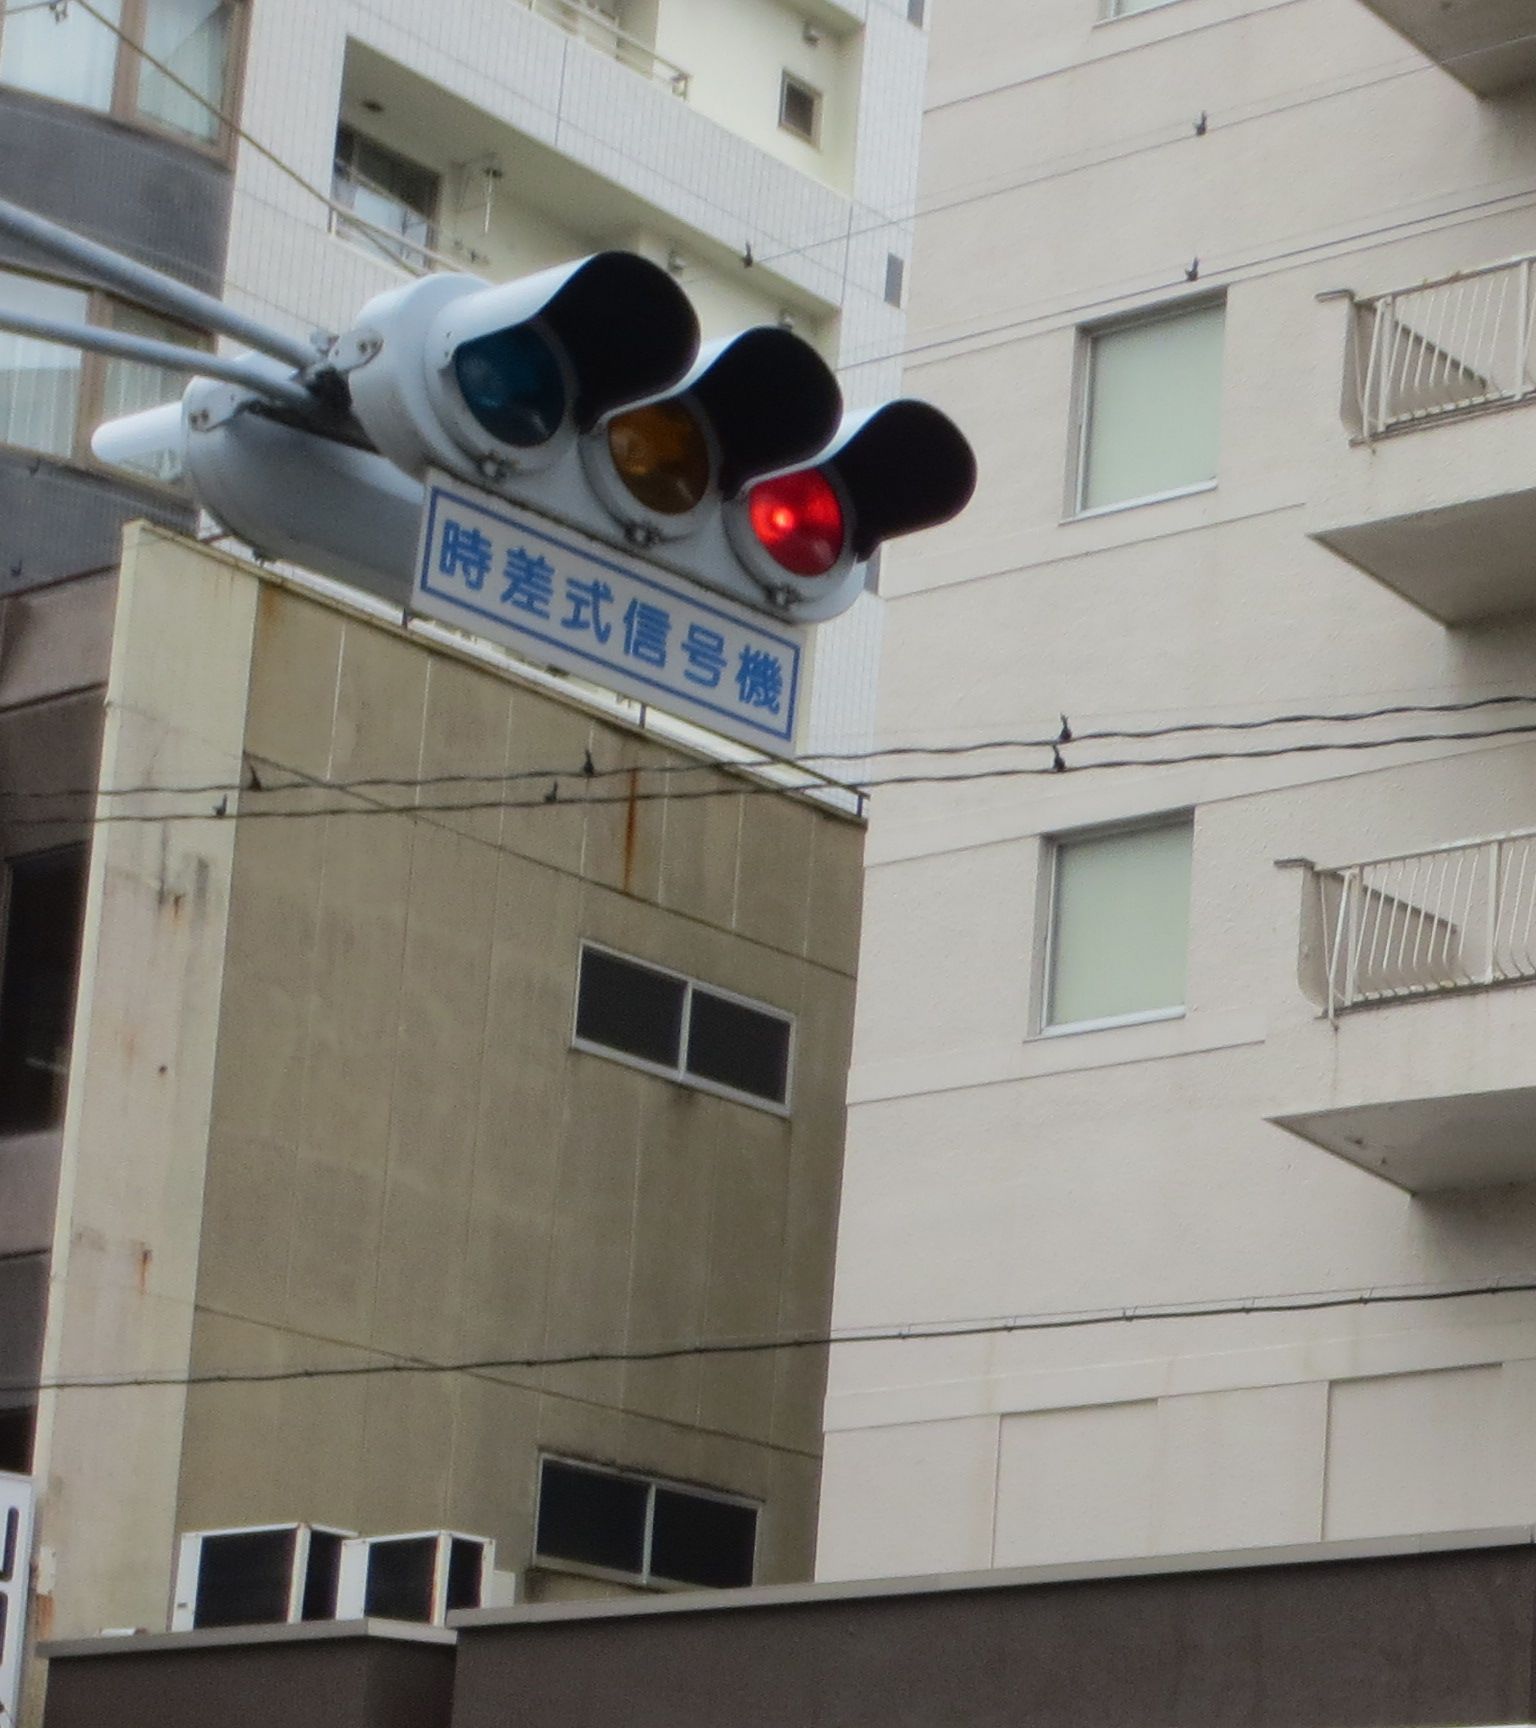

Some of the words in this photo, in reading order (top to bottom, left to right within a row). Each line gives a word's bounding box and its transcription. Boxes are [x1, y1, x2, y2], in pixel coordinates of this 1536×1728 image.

[439, 519, 785, 715] 時差式信号機
